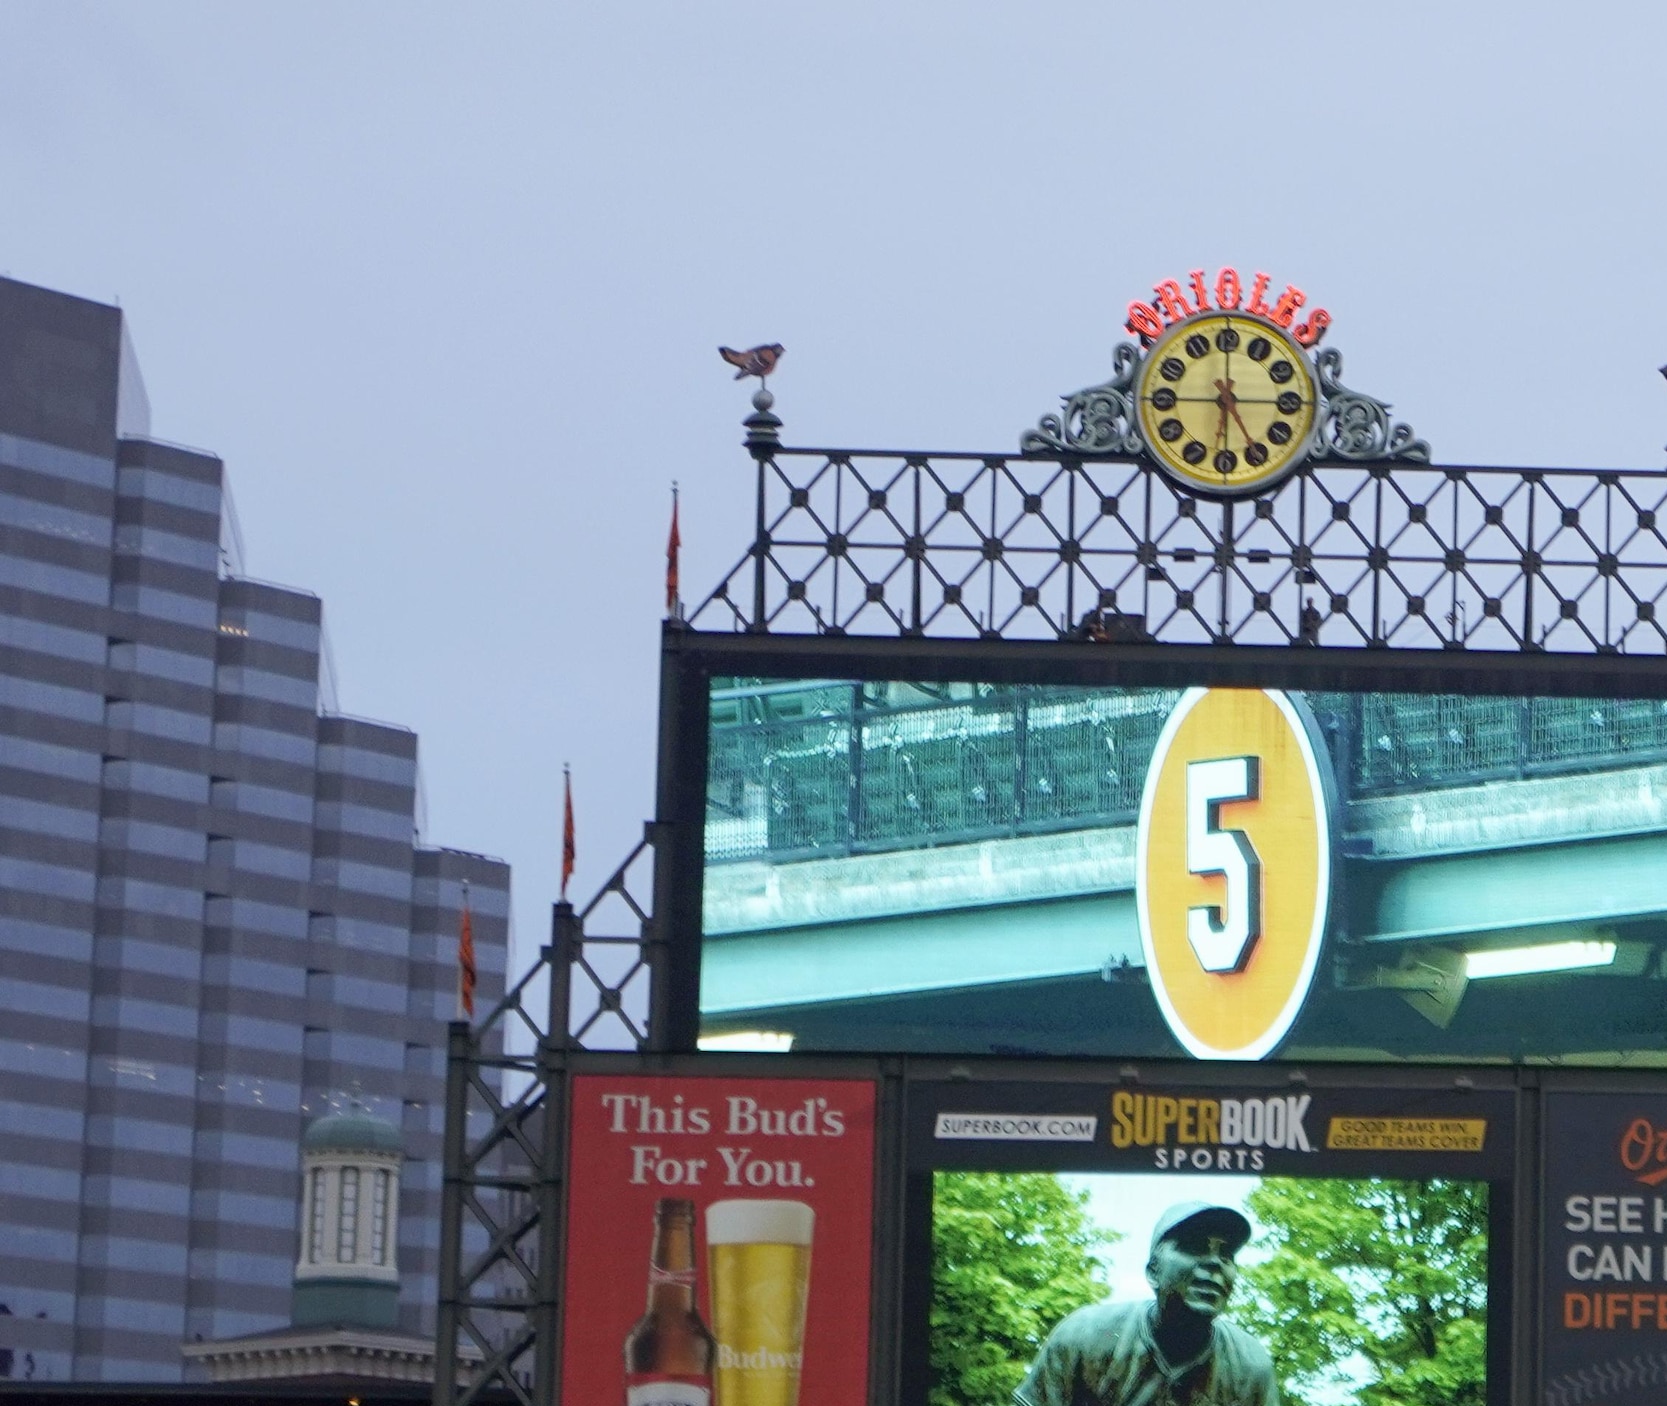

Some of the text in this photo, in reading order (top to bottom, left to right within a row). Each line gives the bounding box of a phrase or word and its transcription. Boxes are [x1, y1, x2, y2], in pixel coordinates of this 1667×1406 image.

[1123, 266, 1333, 347] ORIOLES
[1186, 756, 1263, 973] 5
[600, 1094, 845, 1138] This Bud's
[941, 1119, 1091, 1136] SUPERBOOK.COM
[1111, 1091, 1313, 1152] SUPERBOOK
[1340, 1120, 1387, 1134] GOOD
[1391, 1121, 1435, 1134] TEAMS
[1154, 1147, 1265, 1171] SPORTS
[1332, 1134, 1376, 1147] GREAT
[1381, 1135, 1426, 1147] TEAMS
[628, 1145, 816, 1188] For You.
[1564, 1196, 1645, 1233] SEE
[1566, 1244, 1652, 1282] CAN
